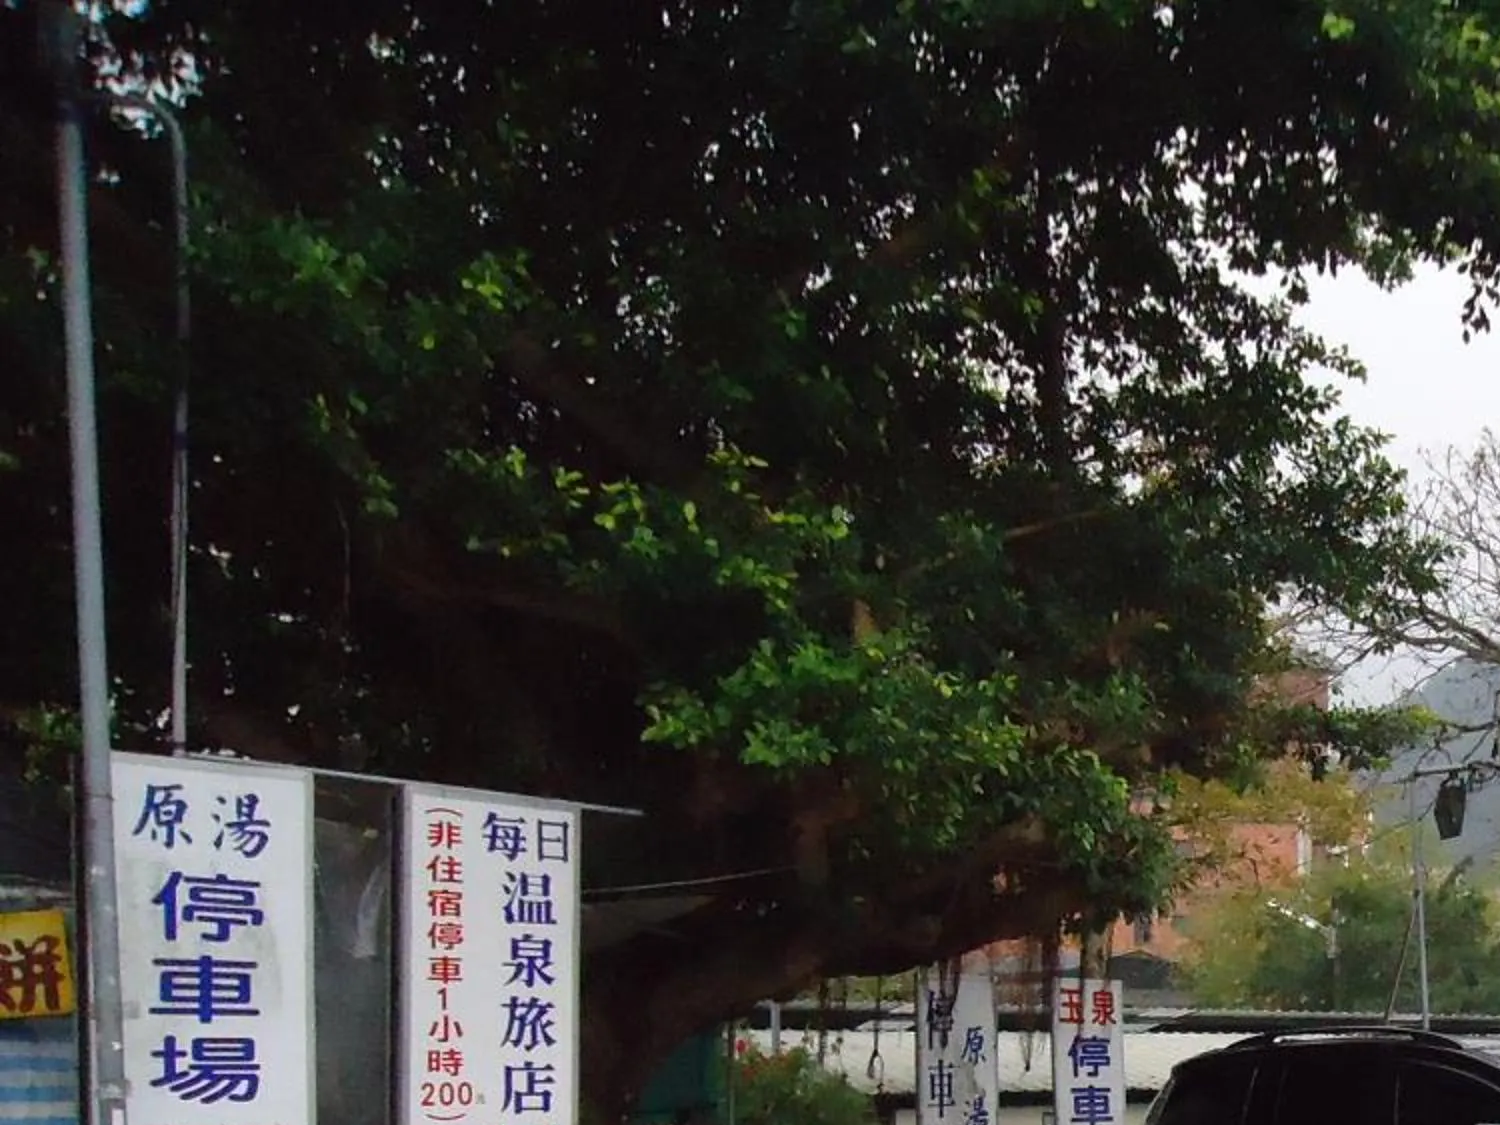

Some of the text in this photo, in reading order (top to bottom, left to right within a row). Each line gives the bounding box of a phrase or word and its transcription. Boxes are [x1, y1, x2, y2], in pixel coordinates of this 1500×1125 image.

[132, 783, 272, 859] 原湯
[481, 811, 571, 864] 每日
[148, 869, 264, 1105] 停車場
